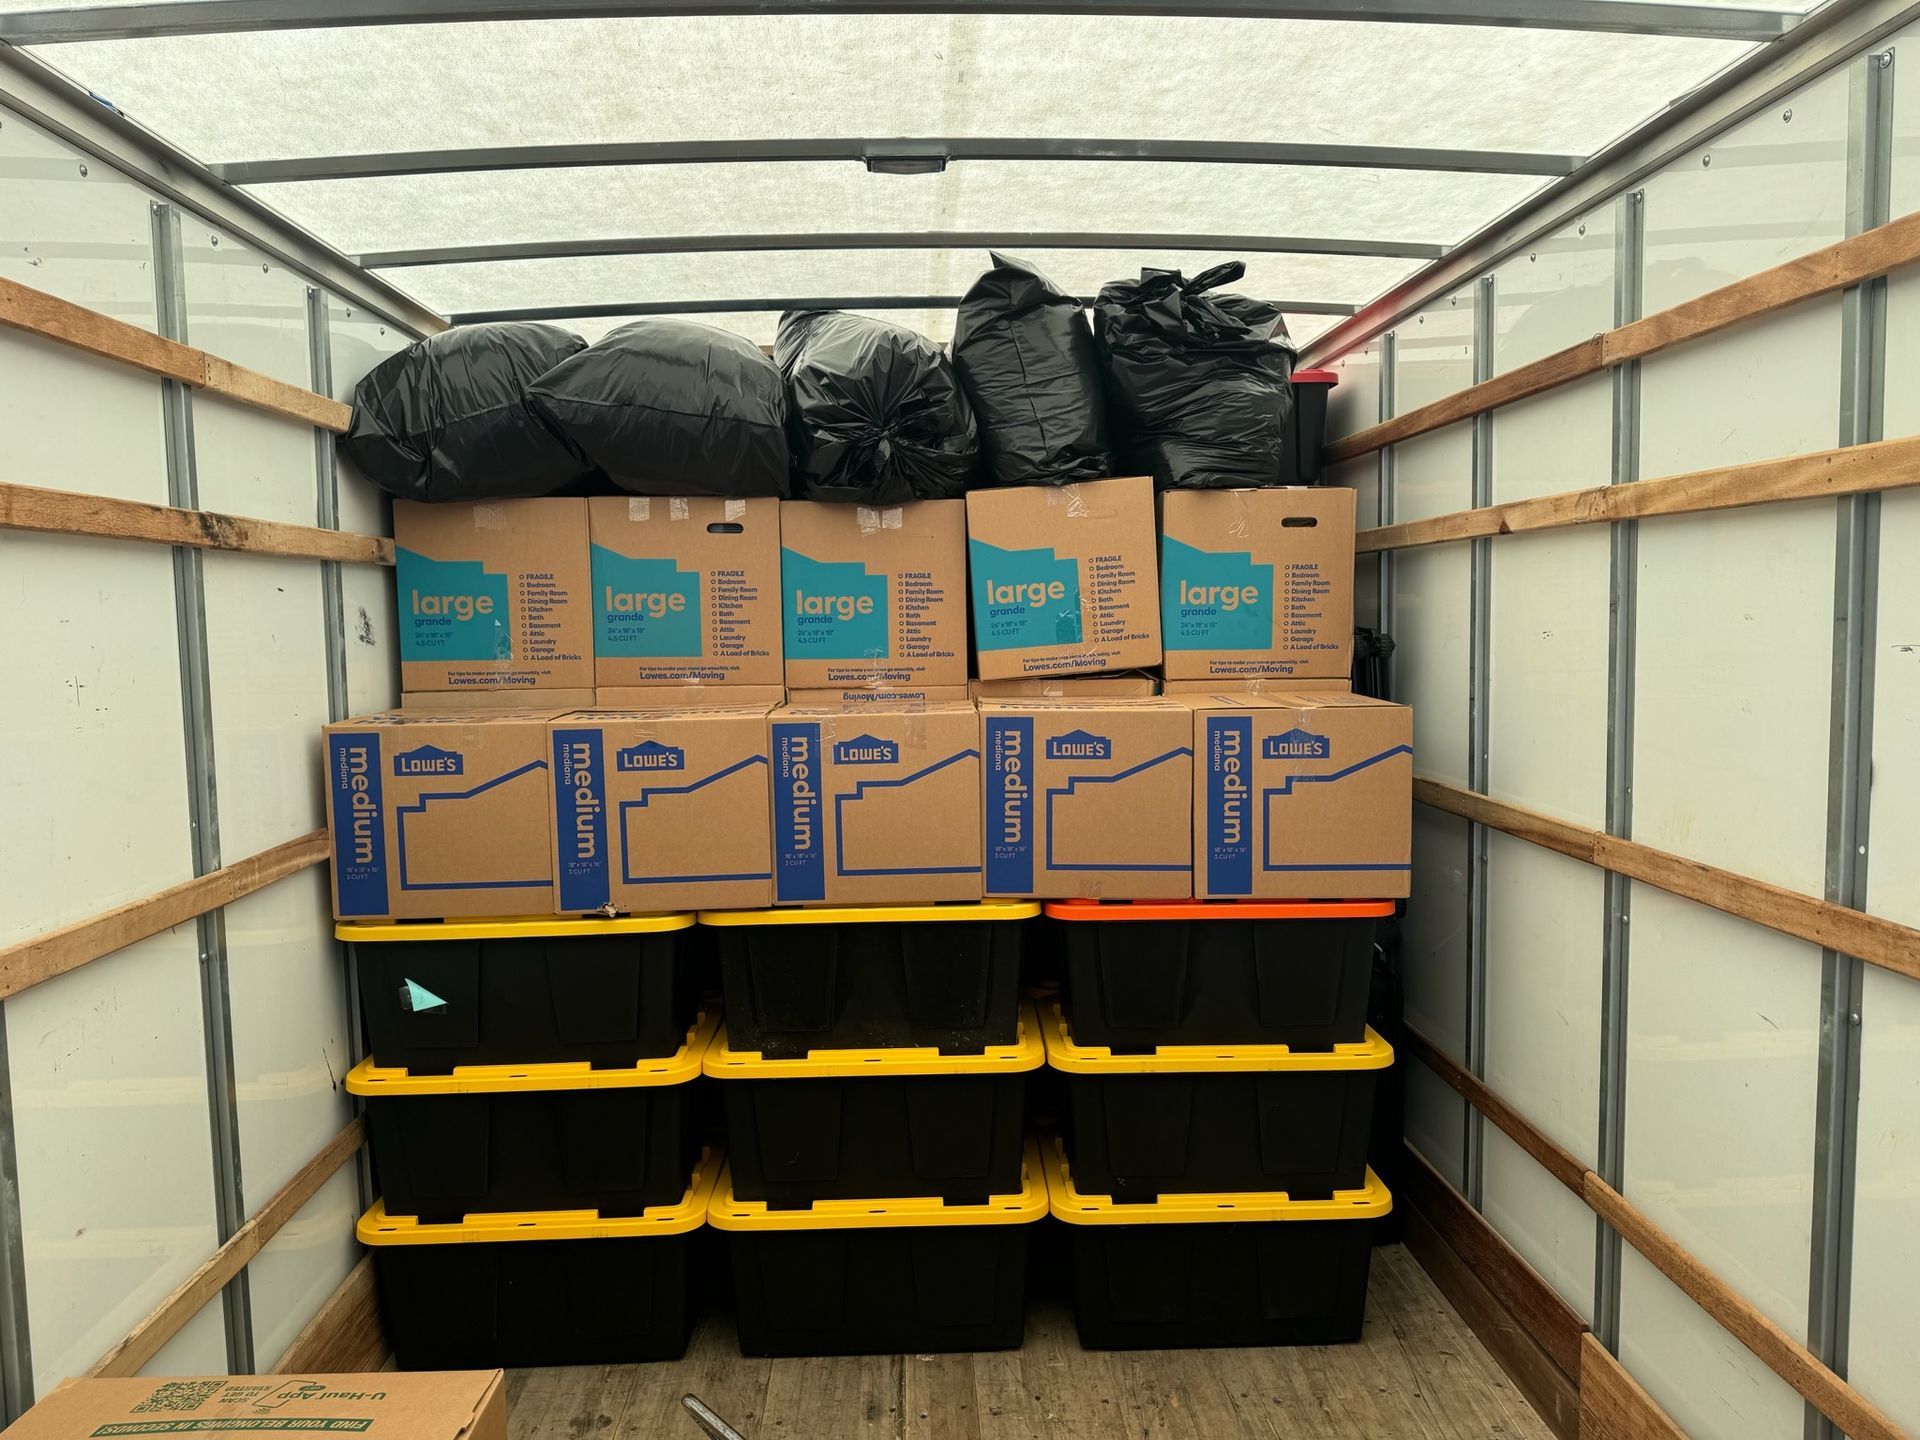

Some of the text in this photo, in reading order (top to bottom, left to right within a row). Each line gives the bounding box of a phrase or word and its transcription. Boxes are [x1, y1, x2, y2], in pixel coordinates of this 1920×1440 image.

[1096, 555, 1122, 563] FRAGILE
[719, 594, 739, 602] Dining
[987, 579, 1065, 608] large
[1180, 580, 1259, 611] large
[412, 588, 494, 621] large
[606, 586, 686, 618] large
[796, 589, 874, 621] large
[1099, 603, 1130, 611] Basement
[607, 612, 644, 624] grande
[990, 605, 1025, 618] grande
[1181, 607, 1217, 618] grande
[414, 617, 452, 628] grande
[797, 615, 833, 626] grande
[720, 634, 746, 642] Laundry
[1024, 658, 1106, 672] Lowes.com/Moving
[1210, 665, 1293, 674] Lowes.com/Moving
[640, 671, 725, 680] Lowes.com/Moving
[843, 692, 925, 701] Lowes.com/Moving
[840, 746, 892, 761] LOWE'S
[995, 730, 1003, 771] mediana
[1053, 741, 1105, 756] LOWE'S
[1214, 730, 1222, 771] mediana
[1270, 741, 1322, 755] LOWE'S
[401, 756, 456, 772] LOWE'S
[563, 744, 572, 785] mediana
[624, 752, 677, 768] LOWE'S
[782, 737, 791, 778] mediana
[339, 747, 350, 790] mediana
[791, 737, 816, 850] medium
[1004, 730, 1028, 843] medium
[1223, 730, 1248, 843] medium
[349, 747, 378, 863] medium
[573, 743, 600, 858] medium
[276, 1392, 311, 1400] App
[100, 1422, 176, 1434] SECONDS!
[193, 1420, 287, 1430] BELONGINGS
[330, 1421, 368, 1429] FIND
